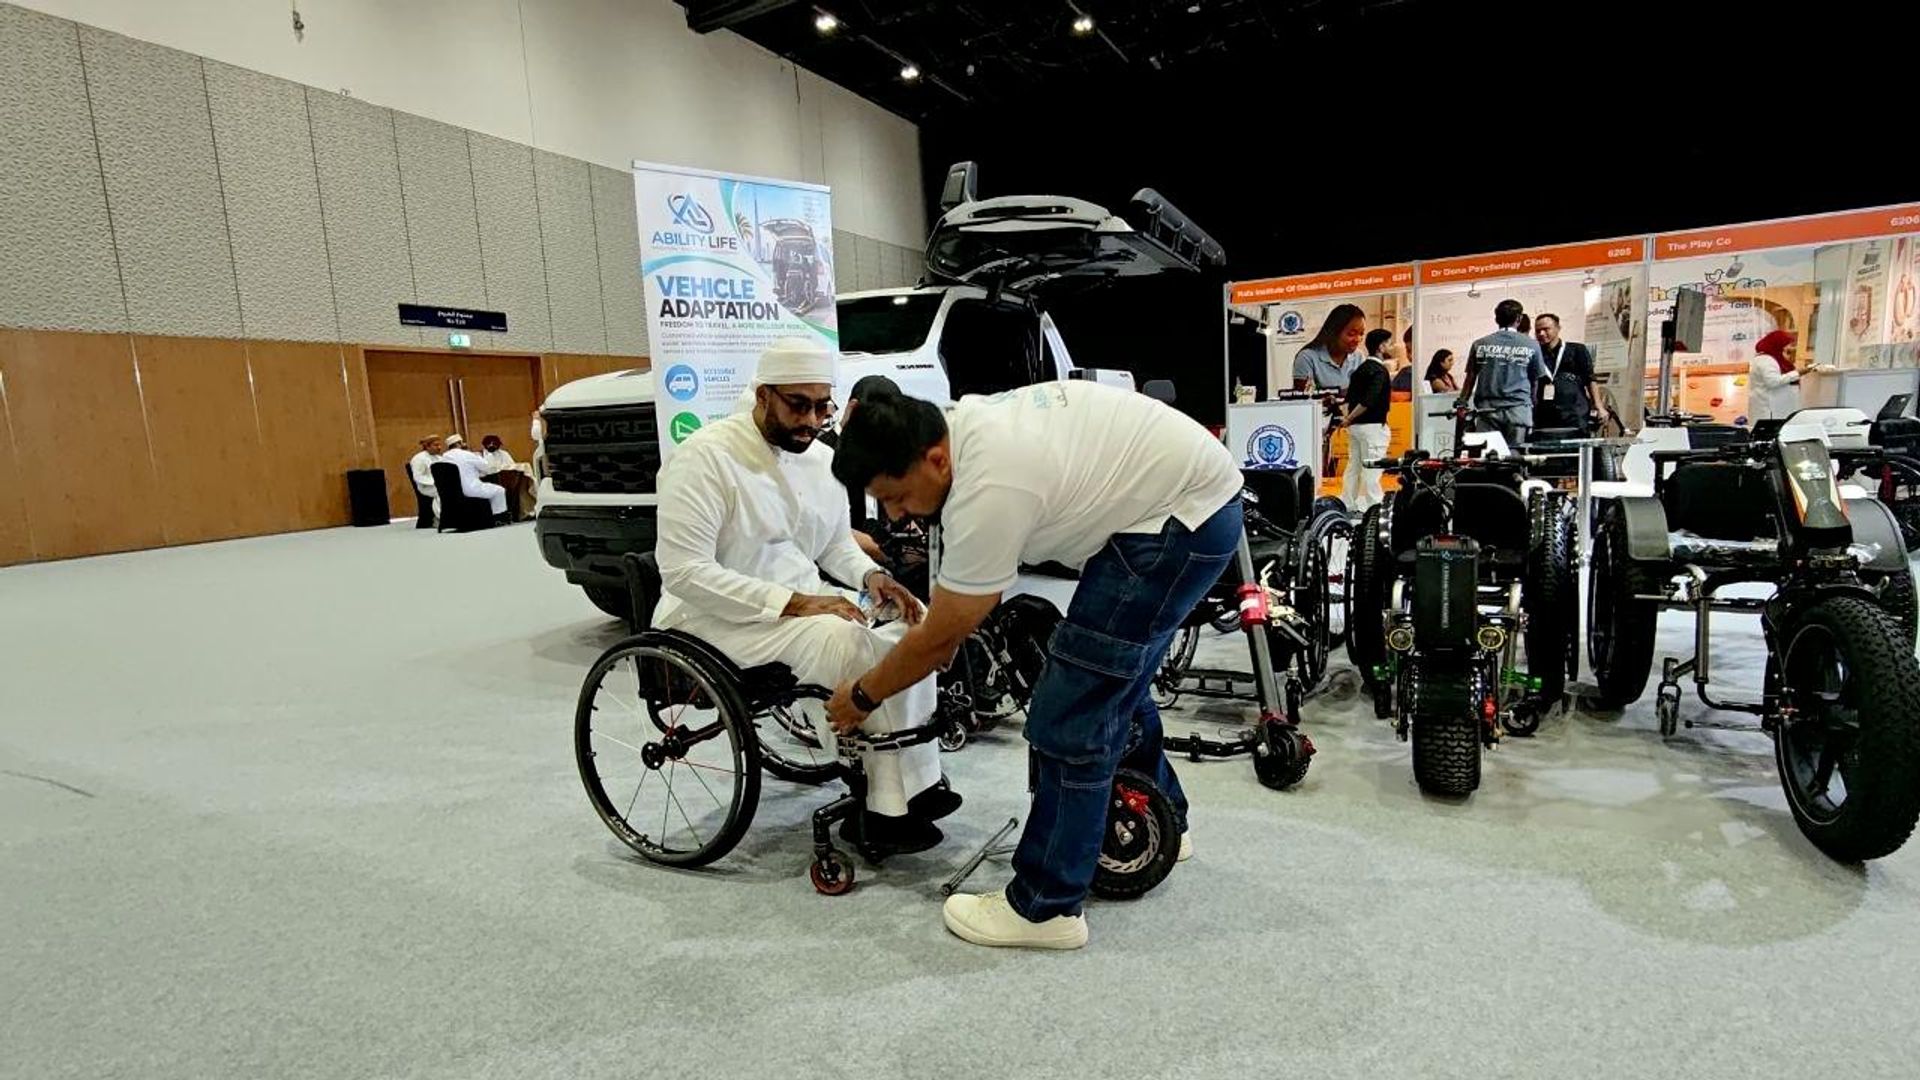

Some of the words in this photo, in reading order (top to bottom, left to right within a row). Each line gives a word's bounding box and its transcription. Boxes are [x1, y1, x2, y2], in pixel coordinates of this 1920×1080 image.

[652, 230, 706, 247] ABILITY
[709, 235, 738, 250] LIFE
[1667, 241, 1688, 252] The
[1689, 238, 1714, 252] Play
[1715, 236, 1732, 247] Co
[1607, 247, 1632, 258] 6205
[1430, 269, 1443, 278] Dr
[1468, 261, 1522, 273] Psychology
[1523, 257, 1552, 267] Clinic
[656, 274, 756, 300] VEHICLE
[1296, 281, 1332, 293] Disability
[1333, 279, 1352, 289] Care
[1353, 276, 1385, 287] Studies
[659, 298, 780, 321] ADAPTATION
[660, 320, 694, 329] FREEDOM
